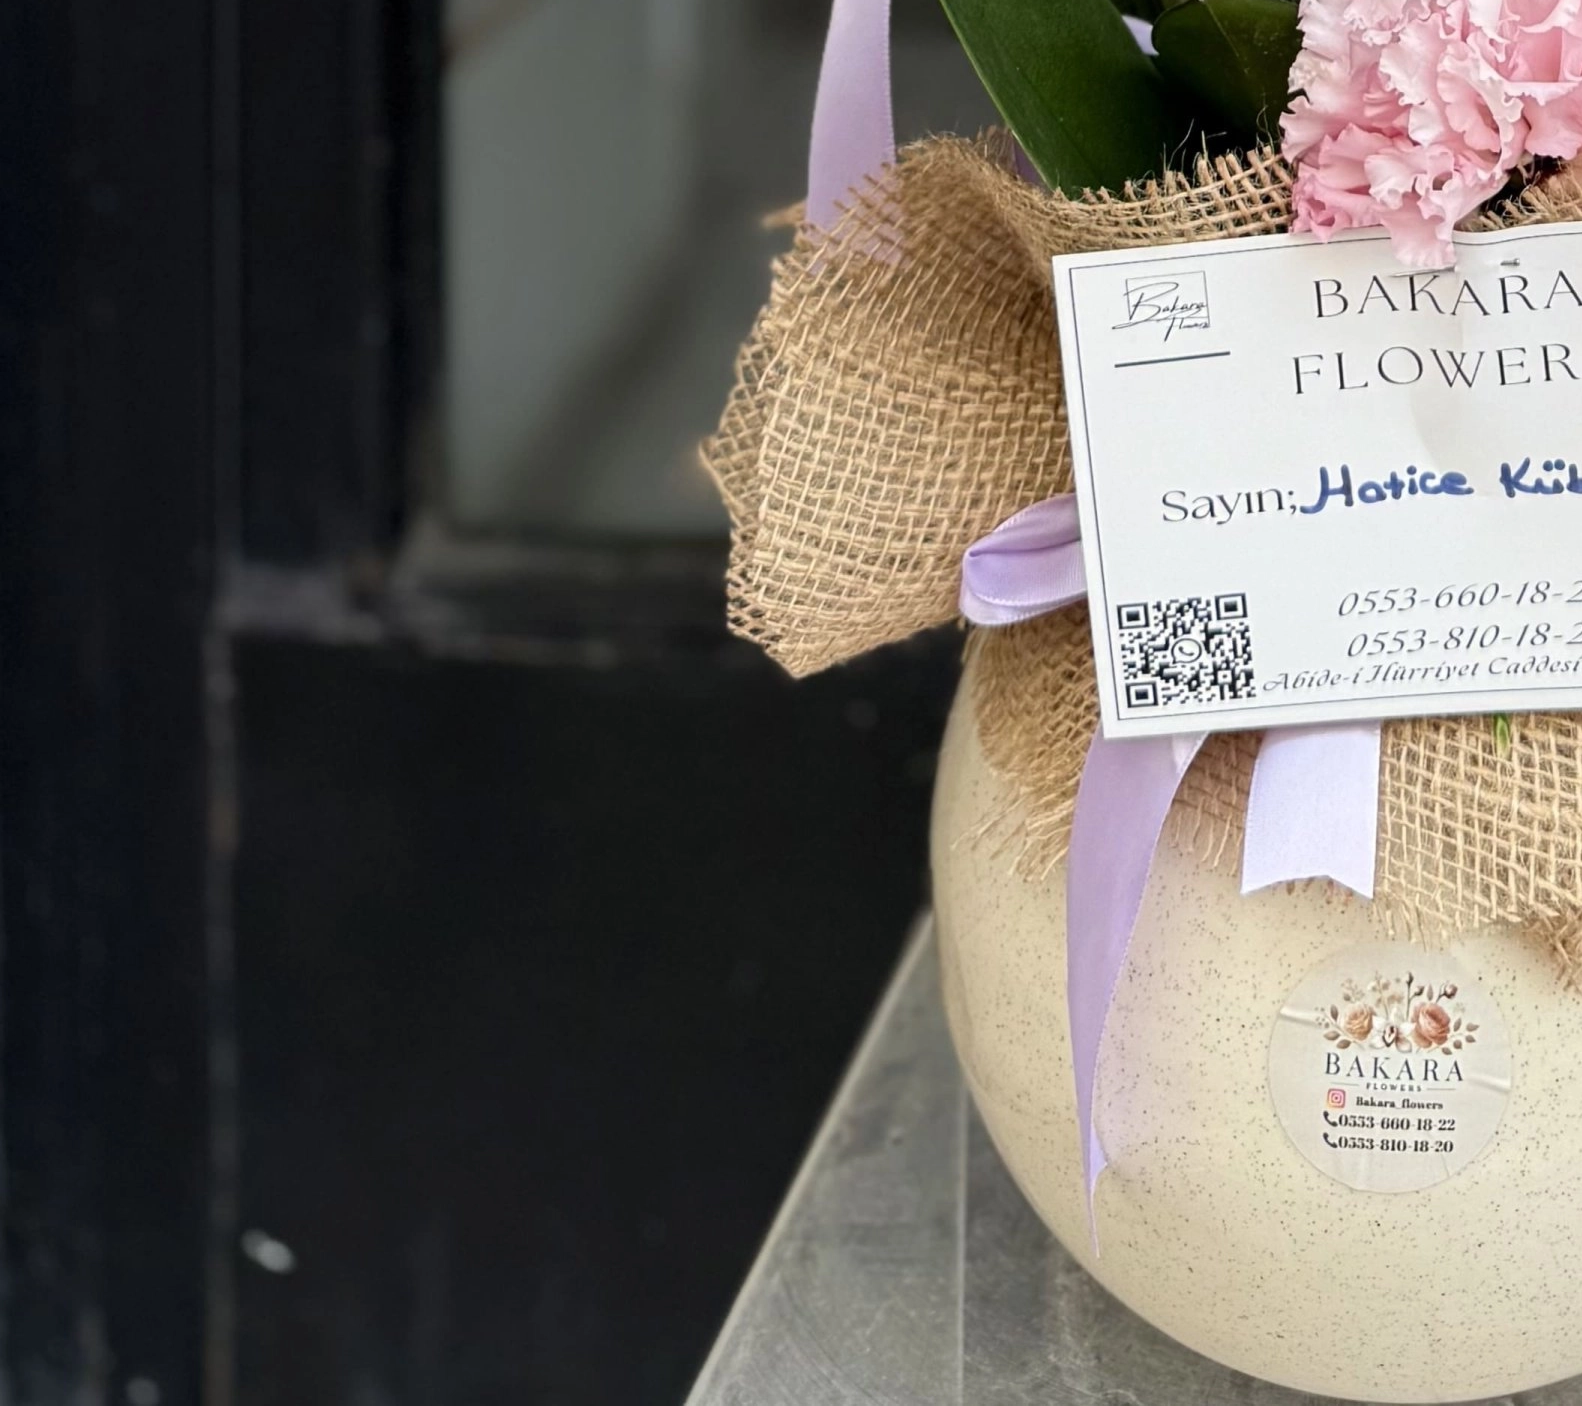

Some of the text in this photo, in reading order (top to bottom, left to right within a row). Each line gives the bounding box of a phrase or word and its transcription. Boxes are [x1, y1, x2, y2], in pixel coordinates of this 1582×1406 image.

[1299, 463, 1474, 515] Hatice
[1161, 487, 1298, 525] Sayın;
[1263, 667, 1364, 691] Abide-i
[1365, 661, 1480, 684] Hürriyet
[1324, 1052, 1463, 1082] BAKARA
[1366, 1082, 1422, 1092] FLOWERS
[1338, 1114, 1456, 1131] 0553-660-18-22
[1338, 1136, 1454, 1152] 0553-810-18-20
